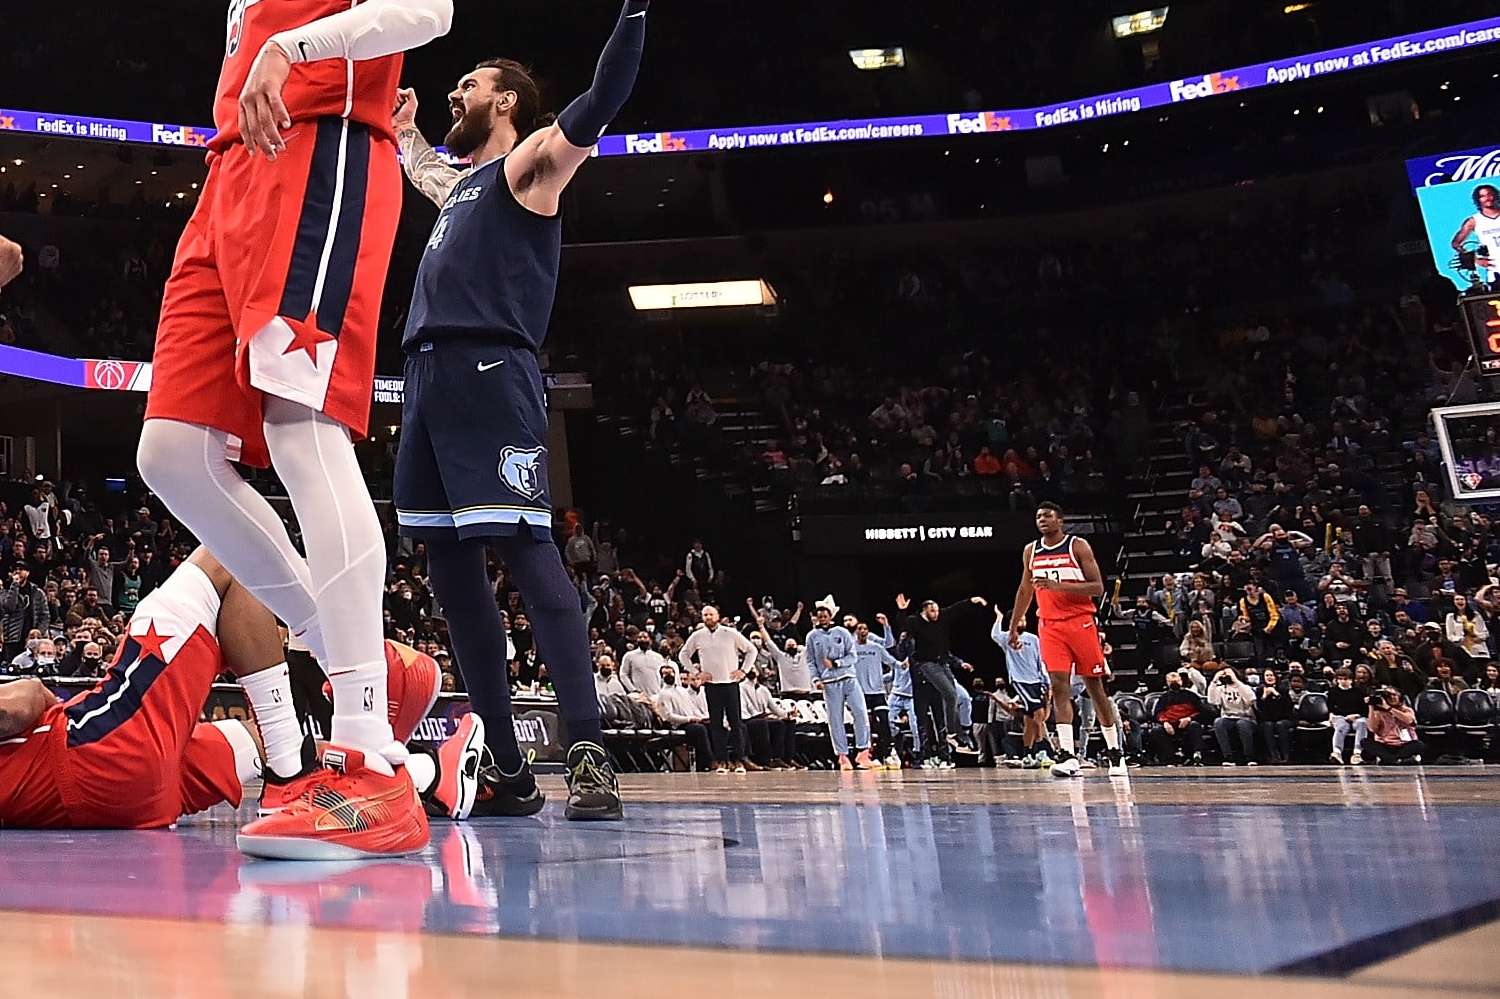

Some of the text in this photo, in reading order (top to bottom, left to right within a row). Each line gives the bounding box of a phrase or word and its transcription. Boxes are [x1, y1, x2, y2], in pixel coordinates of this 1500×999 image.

[1266, 62, 1311, 84] Apply
[1314, 55, 1350, 73] now
[1352, 50, 1371, 67] at
[1169, 72, 1241, 103] FedEx
[947, 111, 1012, 134] FedEx
[1035, 95, 1141, 127] FedEx is Hiring
[37, 117, 126, 141] FedEx is Hiring
[152, 124, 206, 147] FedEx
[708, 122, 923, 149] Apply now at FedEx.com/careers
[625, 131, 687, 154] FedEx
[865, 526, 993, 540] HIBBETT CITY GEAR
